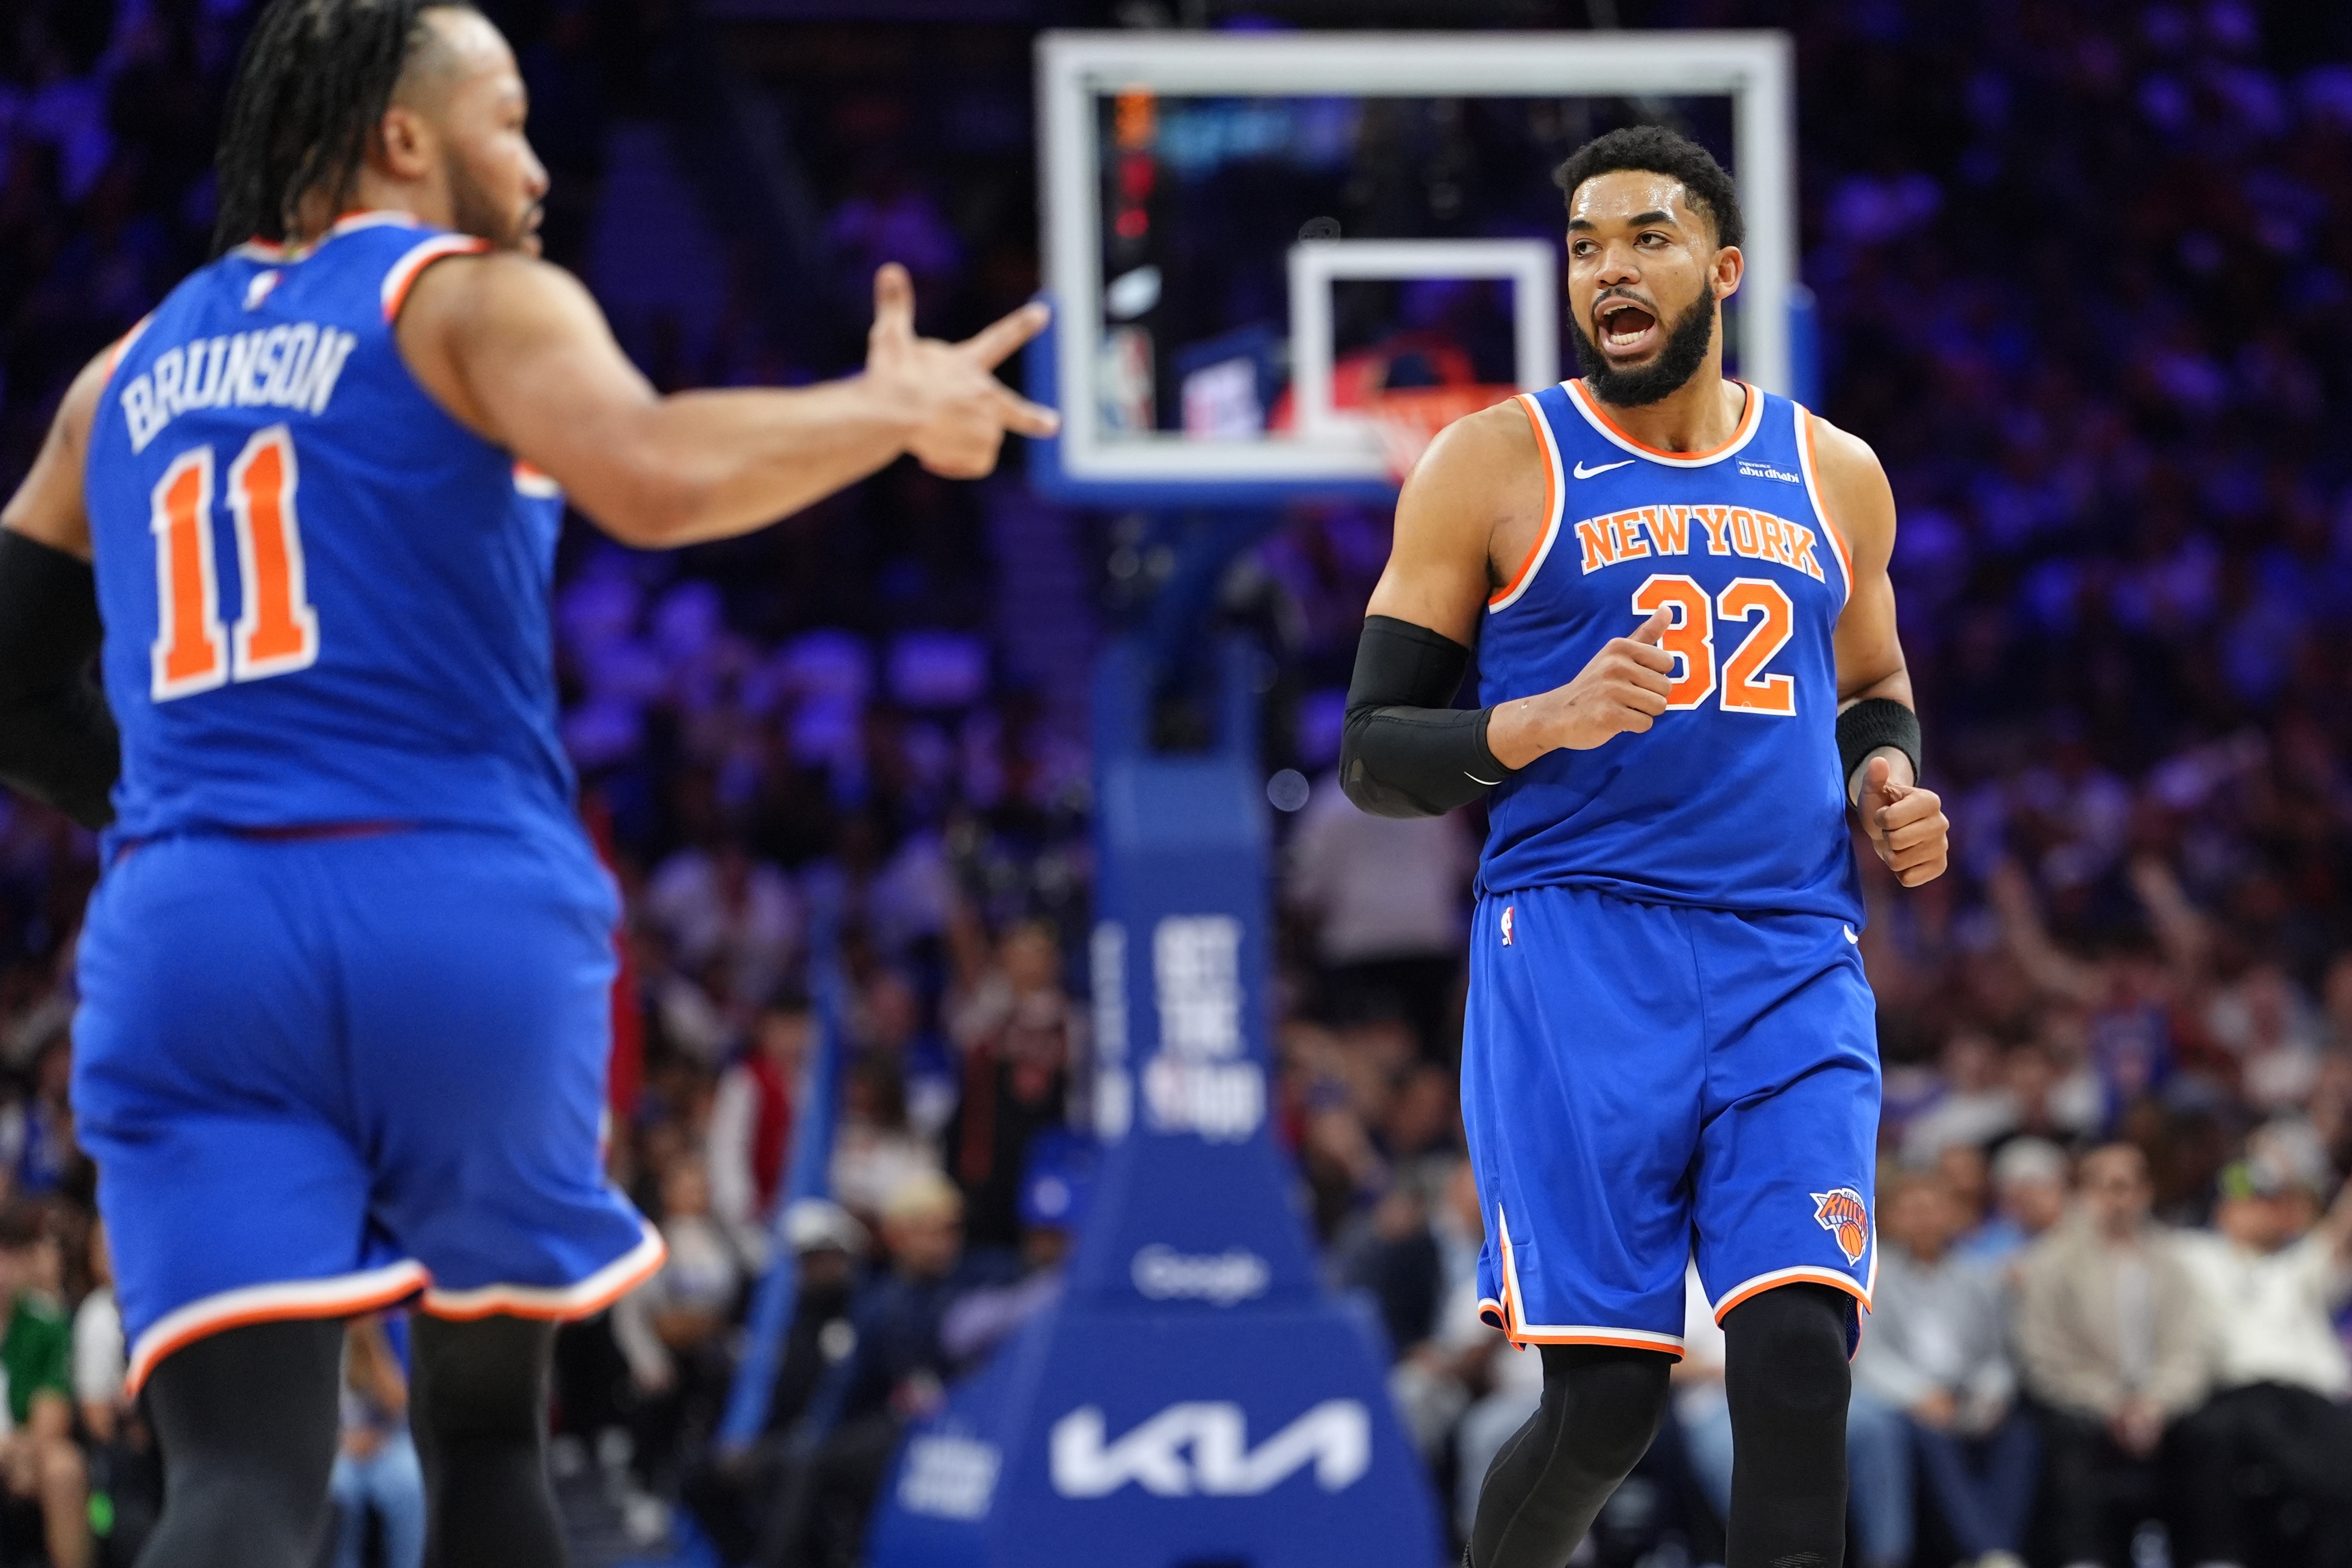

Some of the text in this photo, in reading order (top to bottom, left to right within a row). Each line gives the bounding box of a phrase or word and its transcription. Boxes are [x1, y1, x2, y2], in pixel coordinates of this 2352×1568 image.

[120, 321, 358, 455] BRUNSON
[1740, 467, 1799, 483] abu dhabi
[151, 424, 319, 703] 11
[1574, 504, 1826, 584] NEW YORK
[1632, 574, 1796, 716] 32
